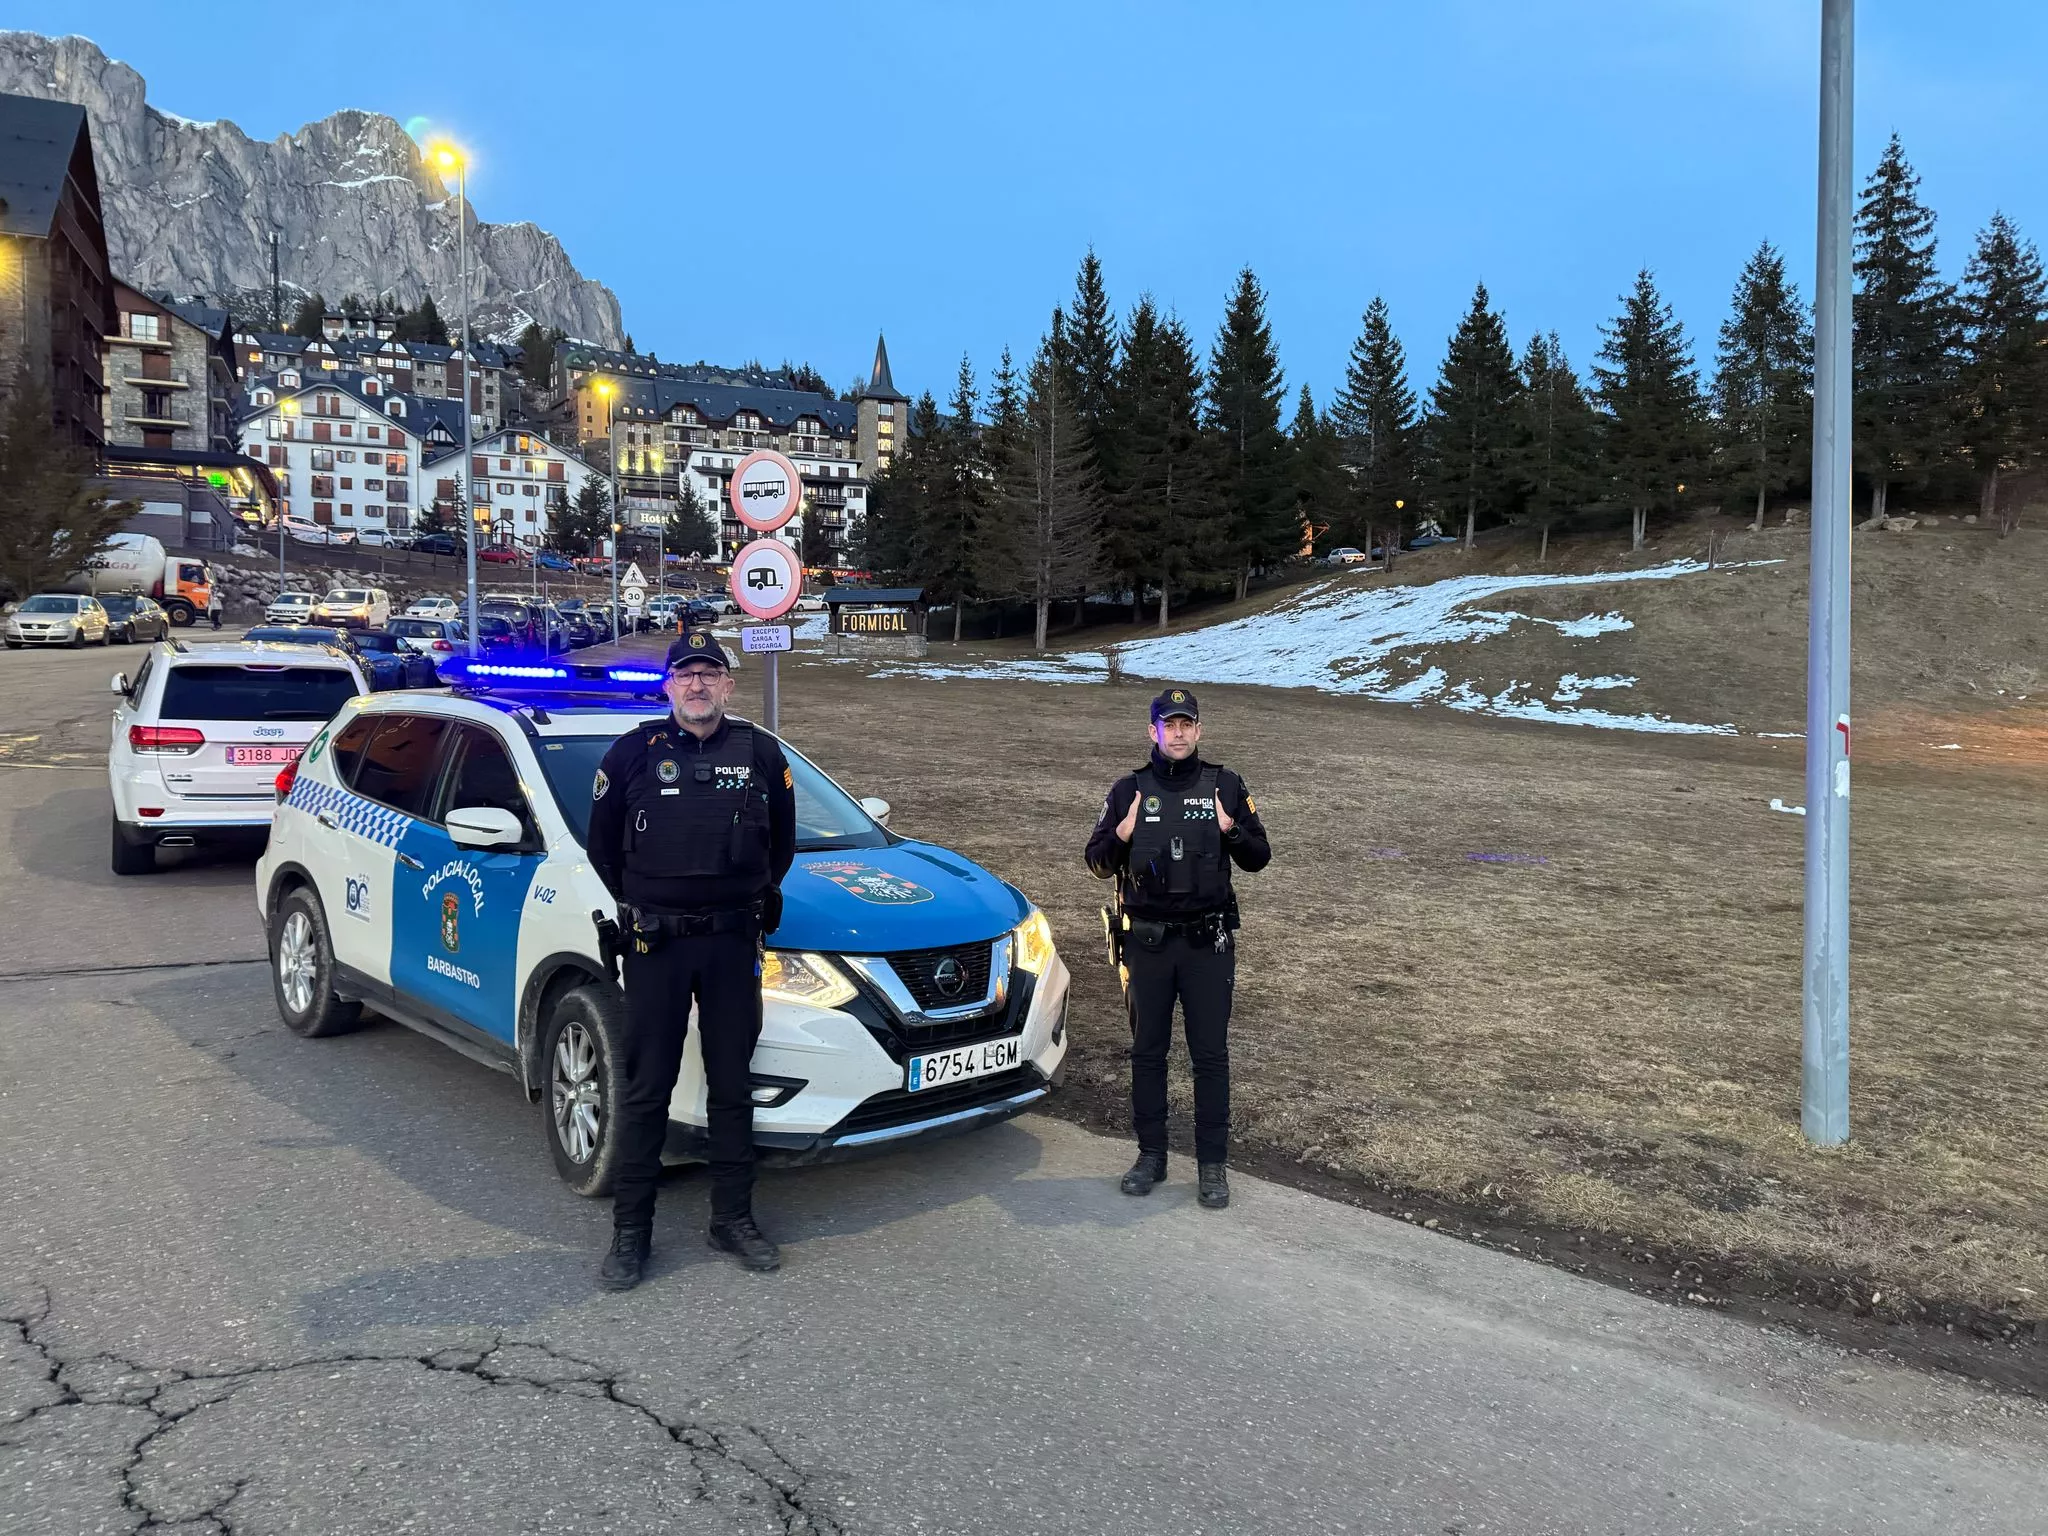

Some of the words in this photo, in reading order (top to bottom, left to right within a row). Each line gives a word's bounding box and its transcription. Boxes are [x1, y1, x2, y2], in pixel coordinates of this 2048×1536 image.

[842, 614, 907, 632] FORMIGAL
[750, 642, 783, 650] DESCARGA
[253, 726, 284, 737] Jeep
[237, 749, 272, 761] 3188
[280, 749, 304, 761] JD
[715, 766, 750, 775] POLICIA
[1183, 798, 1214, 806] POLICIA
[427, 955, 480, 989] BARBASTRO
[926, 1050, 975, 1082] 6754
[983, 1041, 1018, 1070] LGM
